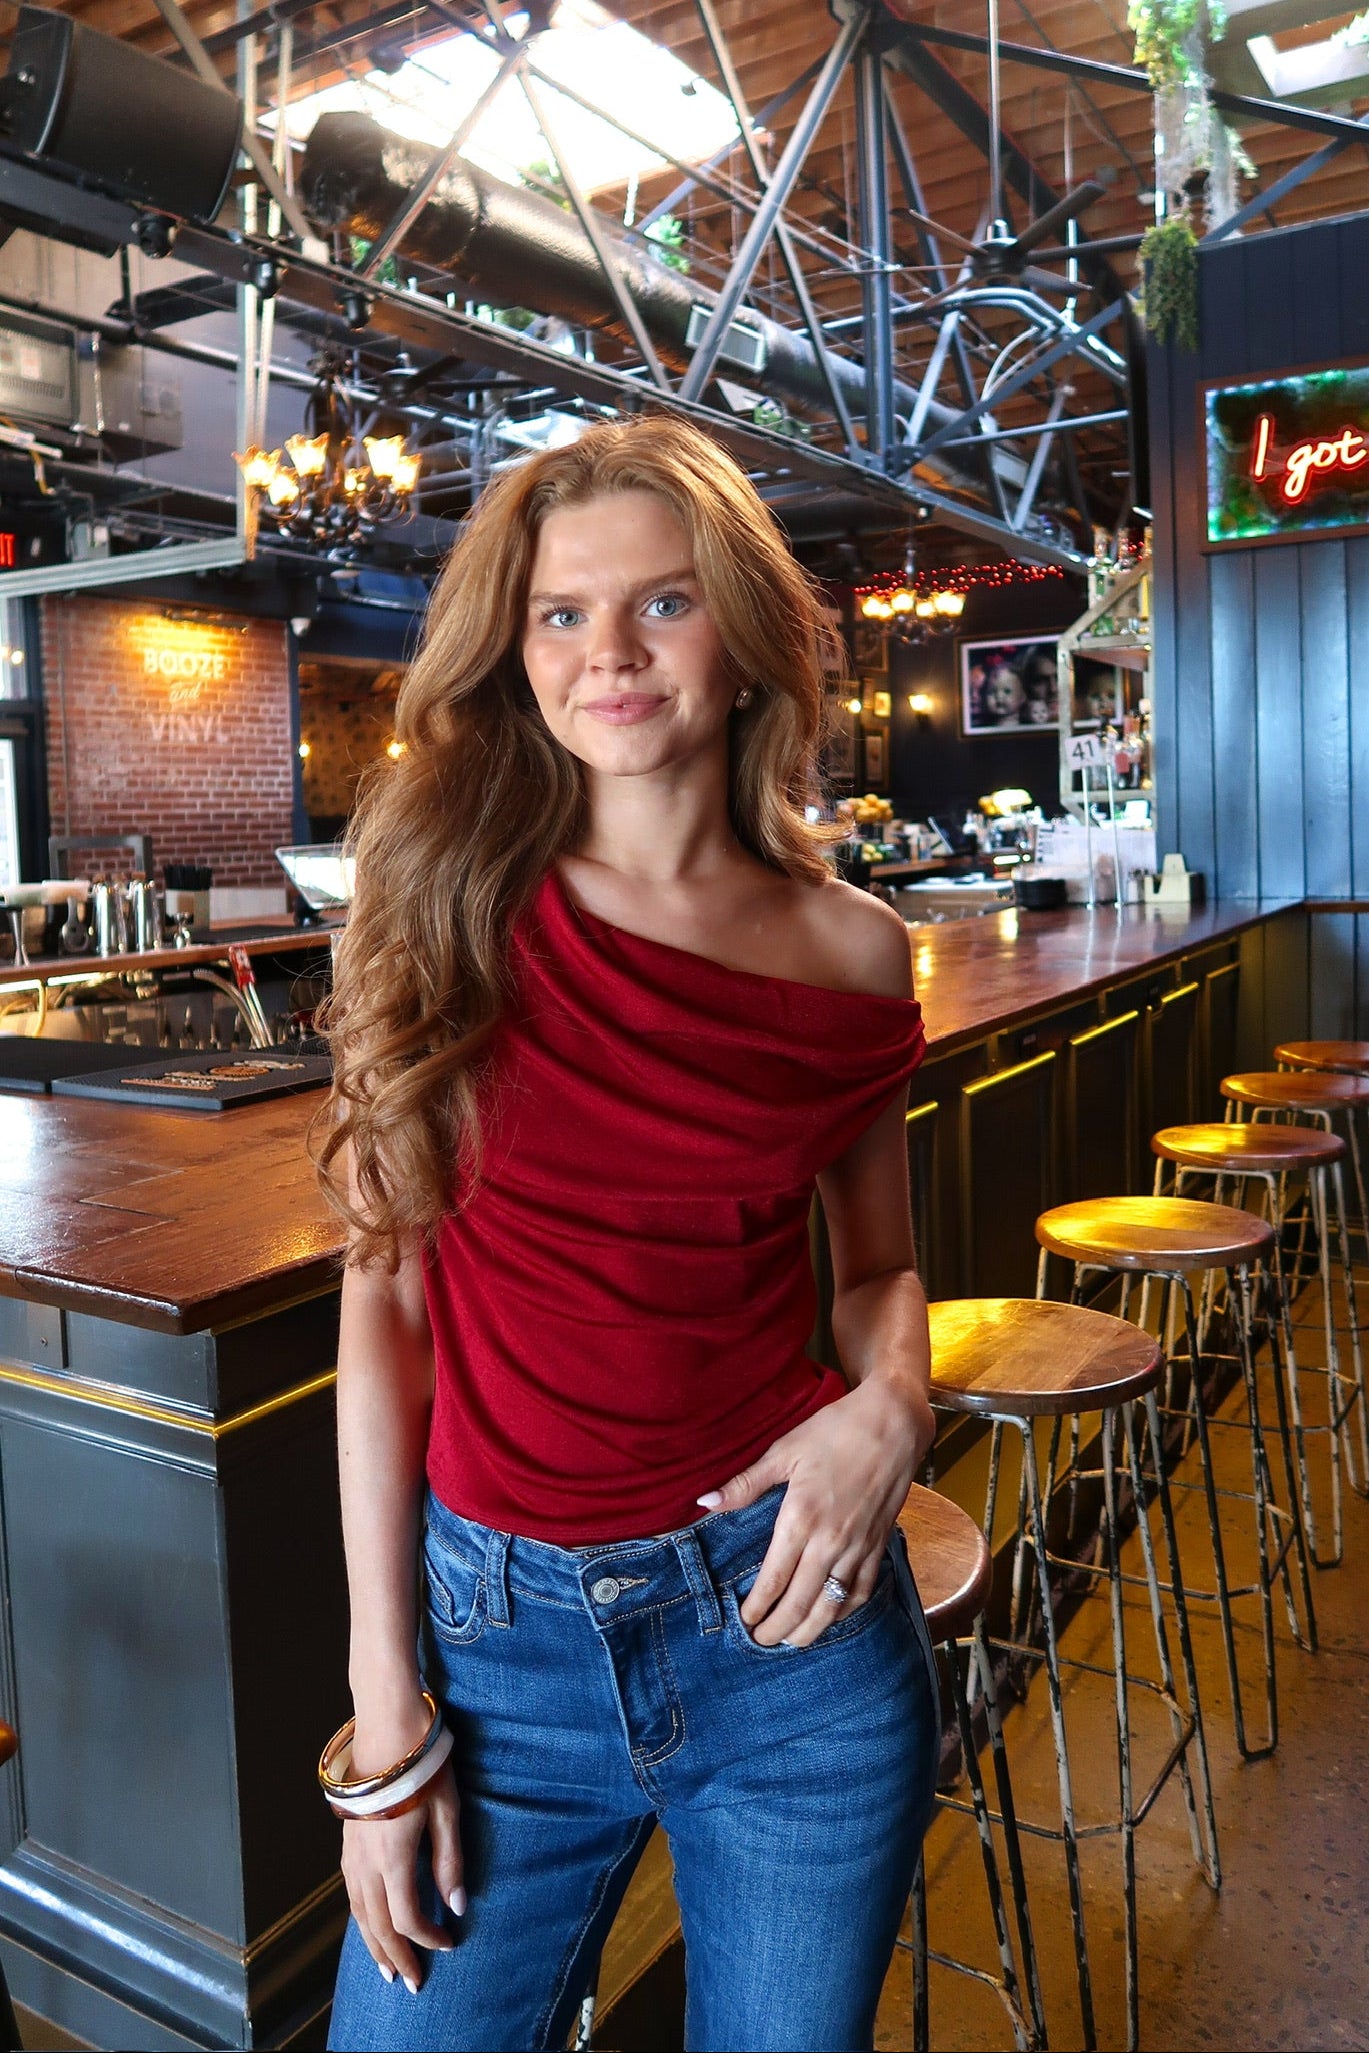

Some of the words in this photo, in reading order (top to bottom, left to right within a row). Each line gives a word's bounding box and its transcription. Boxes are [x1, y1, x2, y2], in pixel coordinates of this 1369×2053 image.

[1254, 417, 1269, 477] I
[1284, 430, 1367, 498] got
[143, 648, 225, 679] BOOZE
[168, 681, 202, 704] and
[147, 713, 229, 744] VINYL
[1072, 740, 1095, 760] 41
